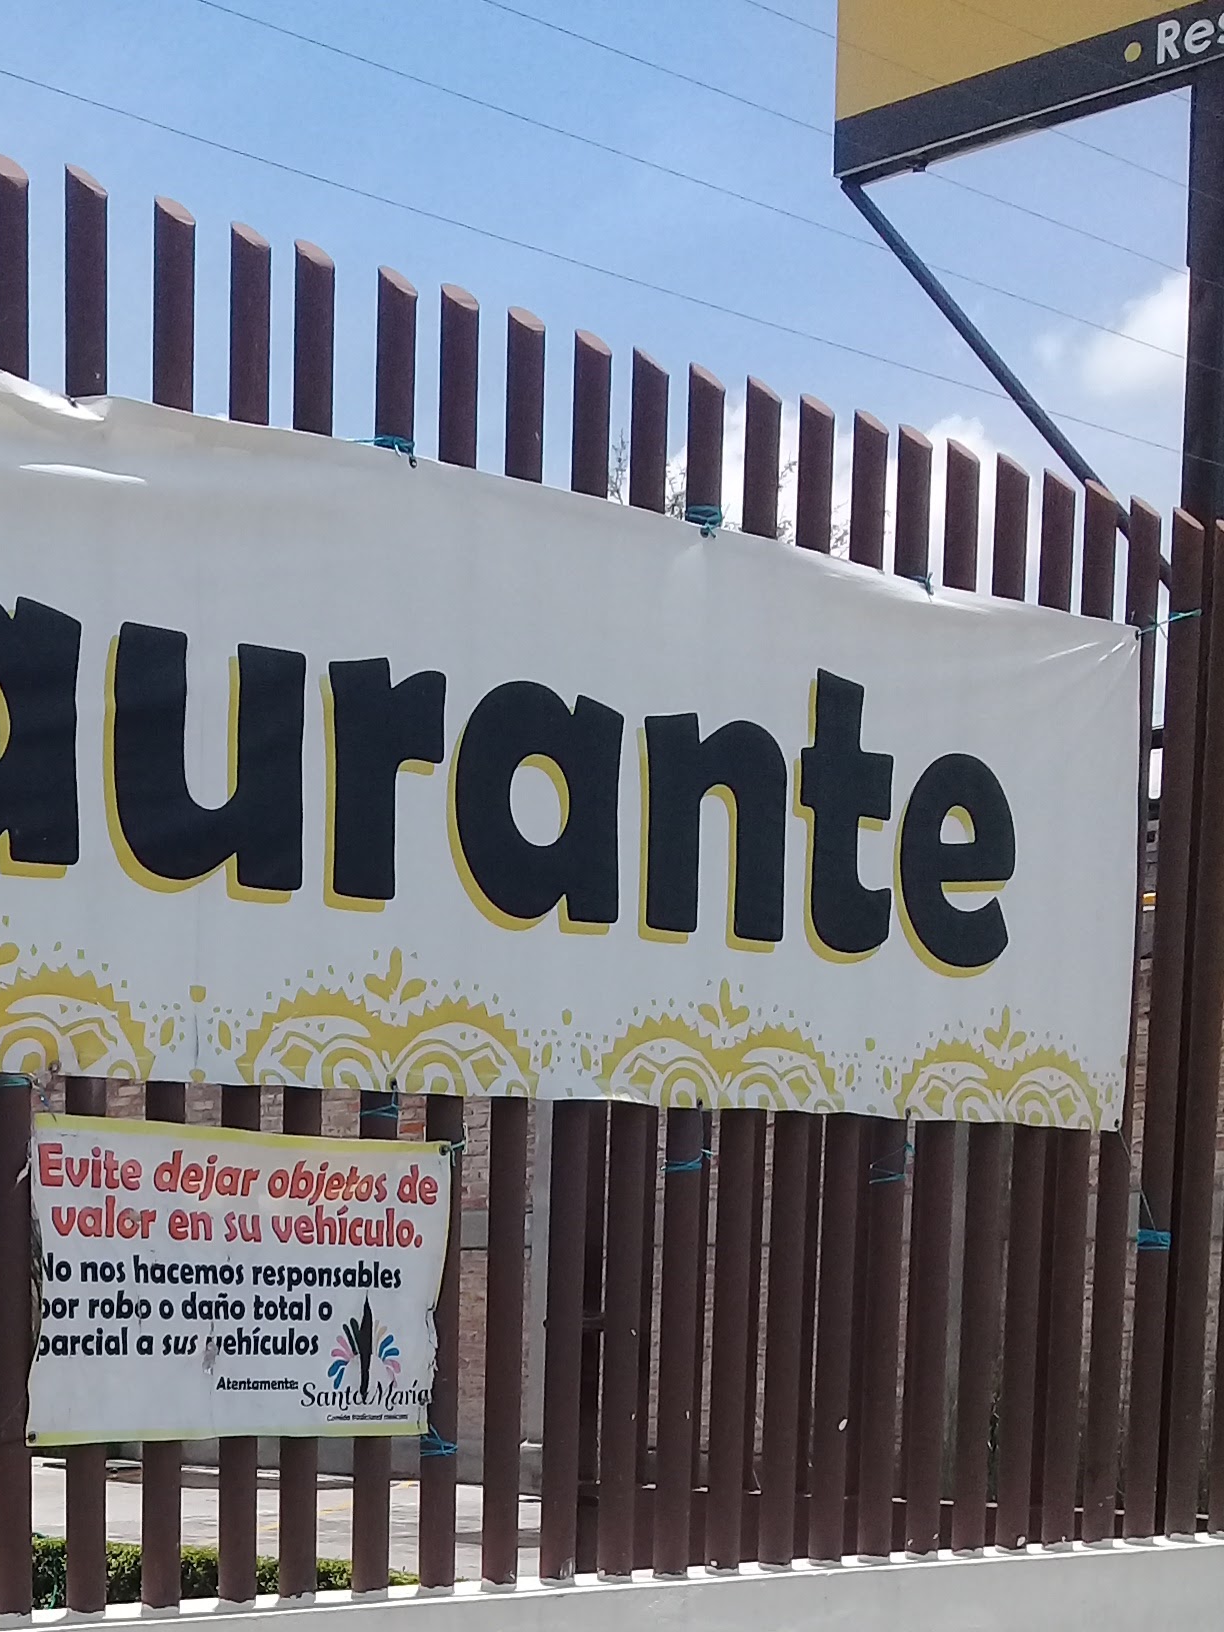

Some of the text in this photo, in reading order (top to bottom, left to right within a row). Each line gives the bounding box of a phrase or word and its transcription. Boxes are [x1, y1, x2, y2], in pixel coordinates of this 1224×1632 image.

[38, 1143, 438, 1206] Evite dejar objetos de
[52, 1195, 423, 1248] valor en su vehículo.
[80, 1261, 126, 1283] nos
[133, 1255, 244, 1285] hacemos
[252, 1260, 402, 1292] responsables
[88, 1290, 152, 1320] robo
[159, 1299, 174, 1320] o
[181, 1291, 246, 1321] daño
[253, 1293, 311, 1321] total
[318, 1301, 333, 1321] o
[36, 1327, 128, 1362] parcial
[136, 1335, 154, 1355] a
[162, 1334, 198, 1355] sus
